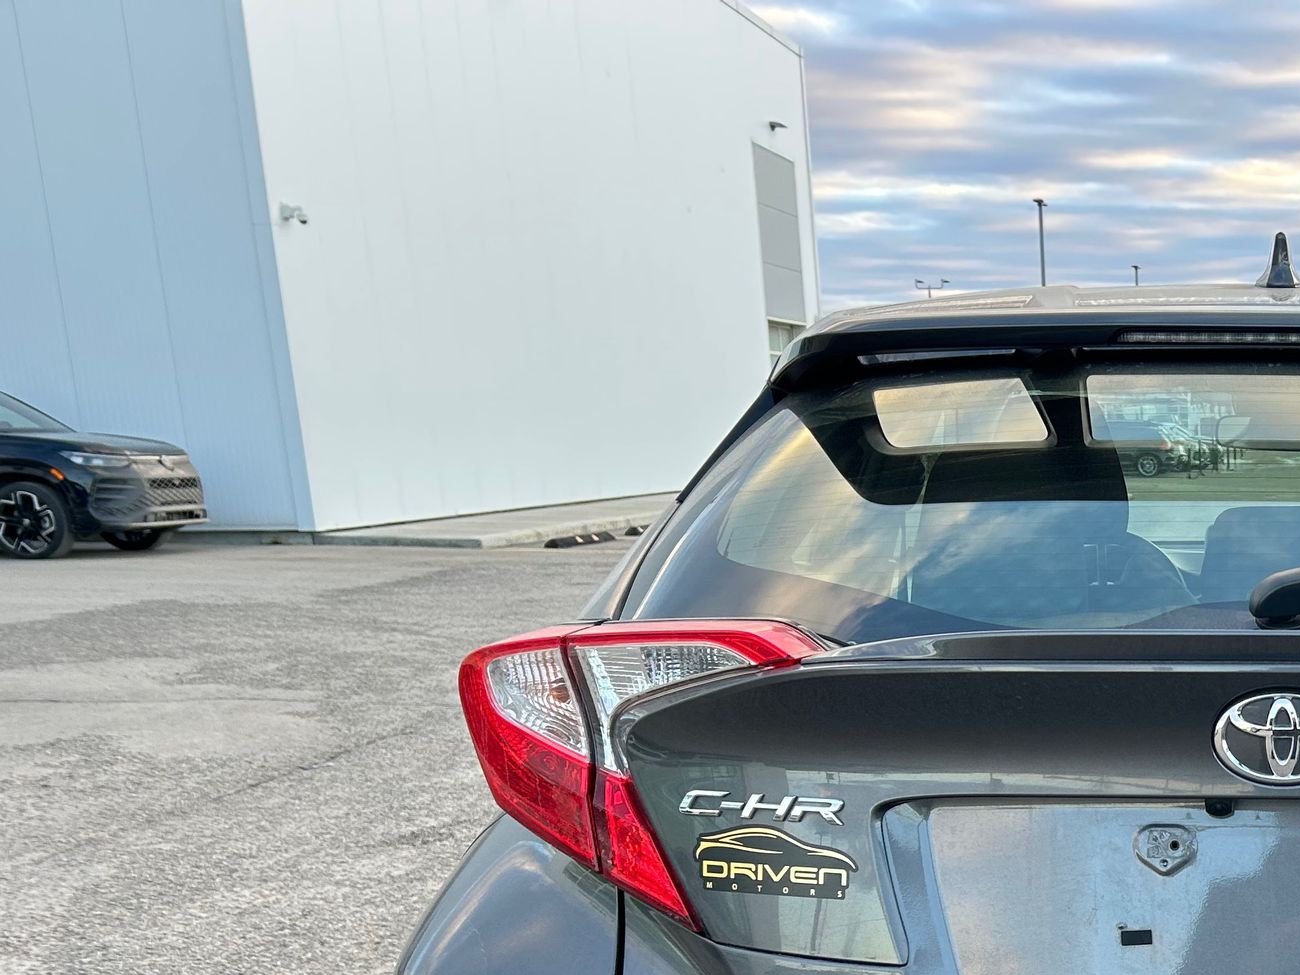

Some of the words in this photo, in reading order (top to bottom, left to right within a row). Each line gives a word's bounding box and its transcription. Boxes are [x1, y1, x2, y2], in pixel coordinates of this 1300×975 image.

[679, 789, 844, 826] C-HR
[702, 860, 848, 887] DRIVEN
[706, 881, 843, 898] MOTORS
